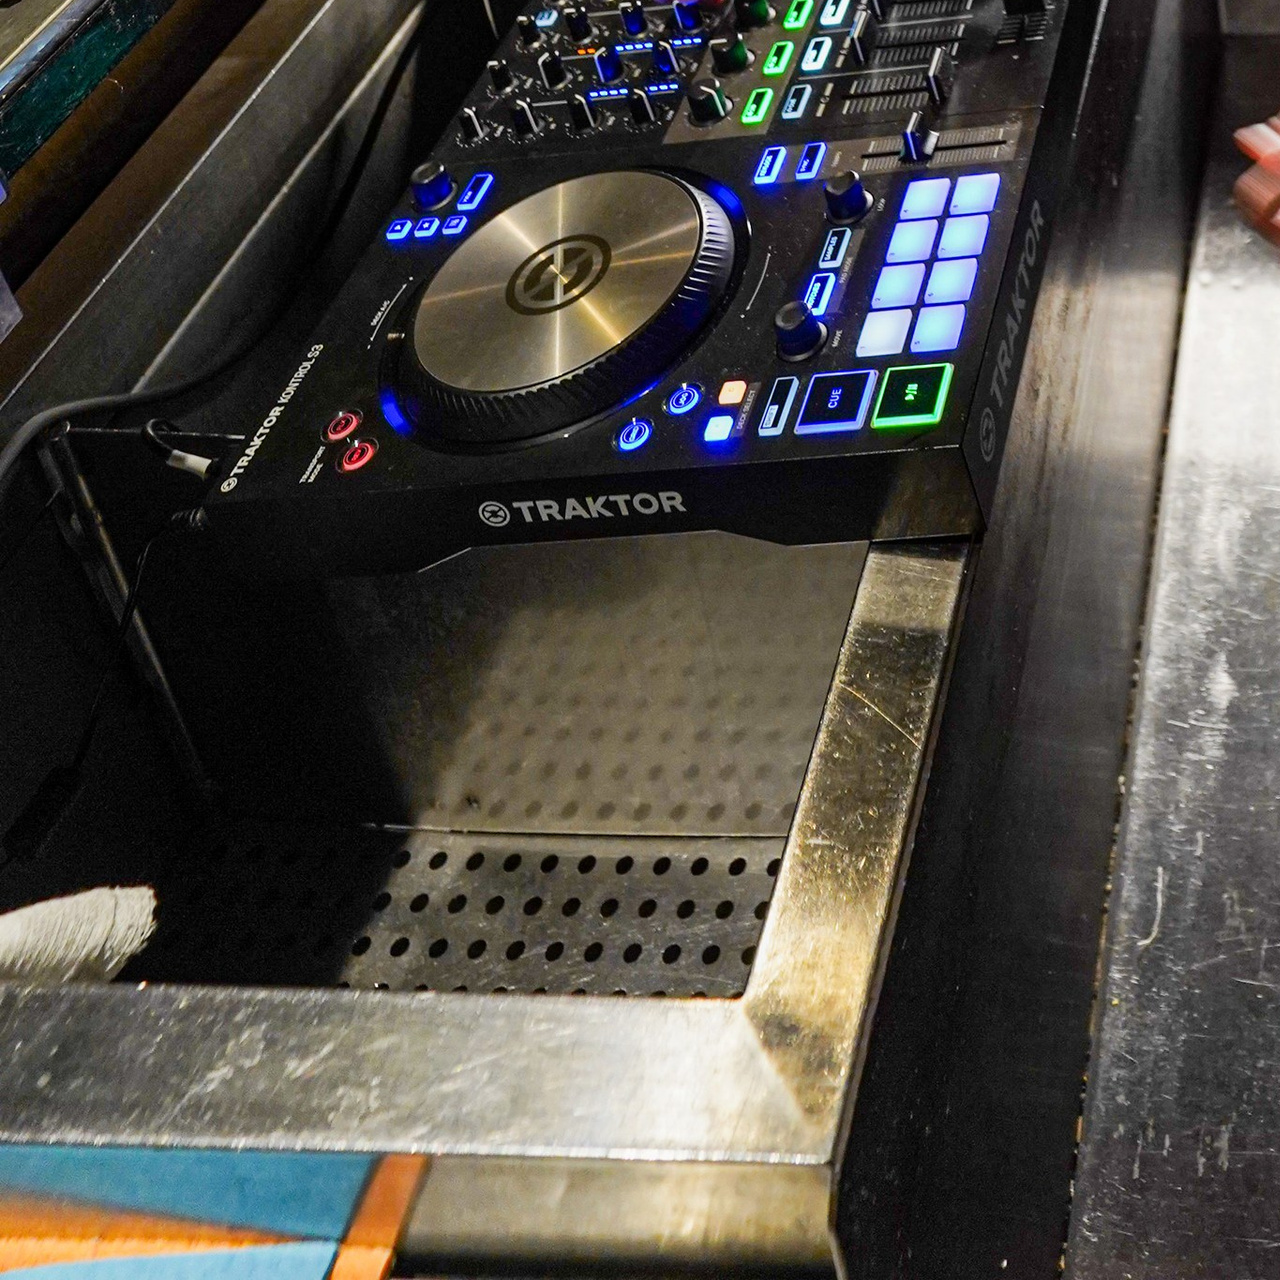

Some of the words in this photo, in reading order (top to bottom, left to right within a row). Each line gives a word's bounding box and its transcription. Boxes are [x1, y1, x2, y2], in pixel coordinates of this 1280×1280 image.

[990, 199, 1044, 409] TRAKTOR
[230, 406, 285, 477] TRAKTOR
[277, 358, 316, 404] KONTROL
[307, 343, 324, 359] S3
[743, 389, 757, 415] SELECT
[828, 387, 842, 409] CUE
[299, 445, 326, 484] TRANSPORT
[307, 462, 324, 483] MODE
[512, 491, 687, 523] TRAKTOR
